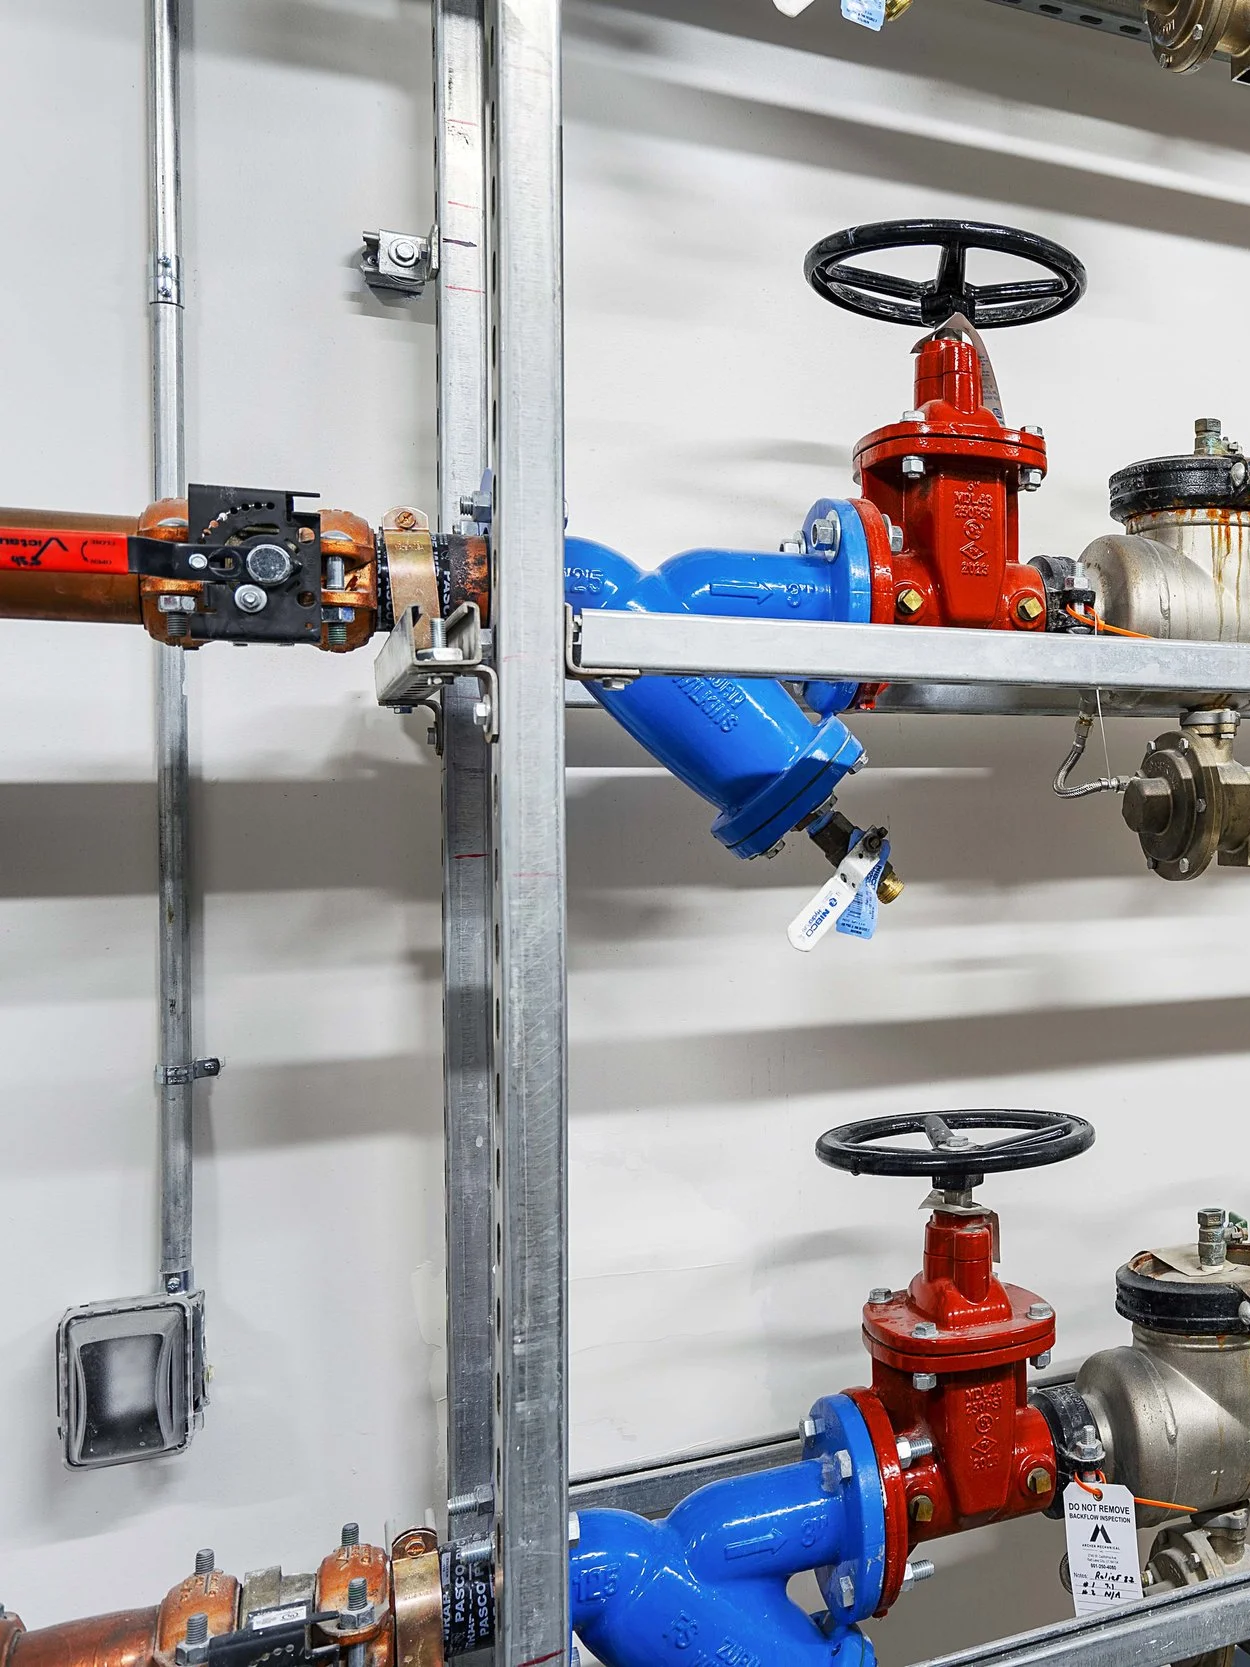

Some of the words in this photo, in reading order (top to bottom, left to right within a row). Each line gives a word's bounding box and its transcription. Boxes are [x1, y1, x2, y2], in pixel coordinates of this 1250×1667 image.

[805, 908, 830, 938] NIBCO
[1068, 1502, 1080, 1511] DO
[1081, 1503, 1097, 1512] NOT
[1098, 1504, 1130, 1515] REMOVE
[1069, 1512, 1099, 1521] BACKFLOW
[1099, 1515, 1131, 1523] INSPECTION
[454, 1564, 465, 1623] PASCO
[1104, 1590, 1121, 1601] N/A
[475, 1581, 489, 1637] PASCO
